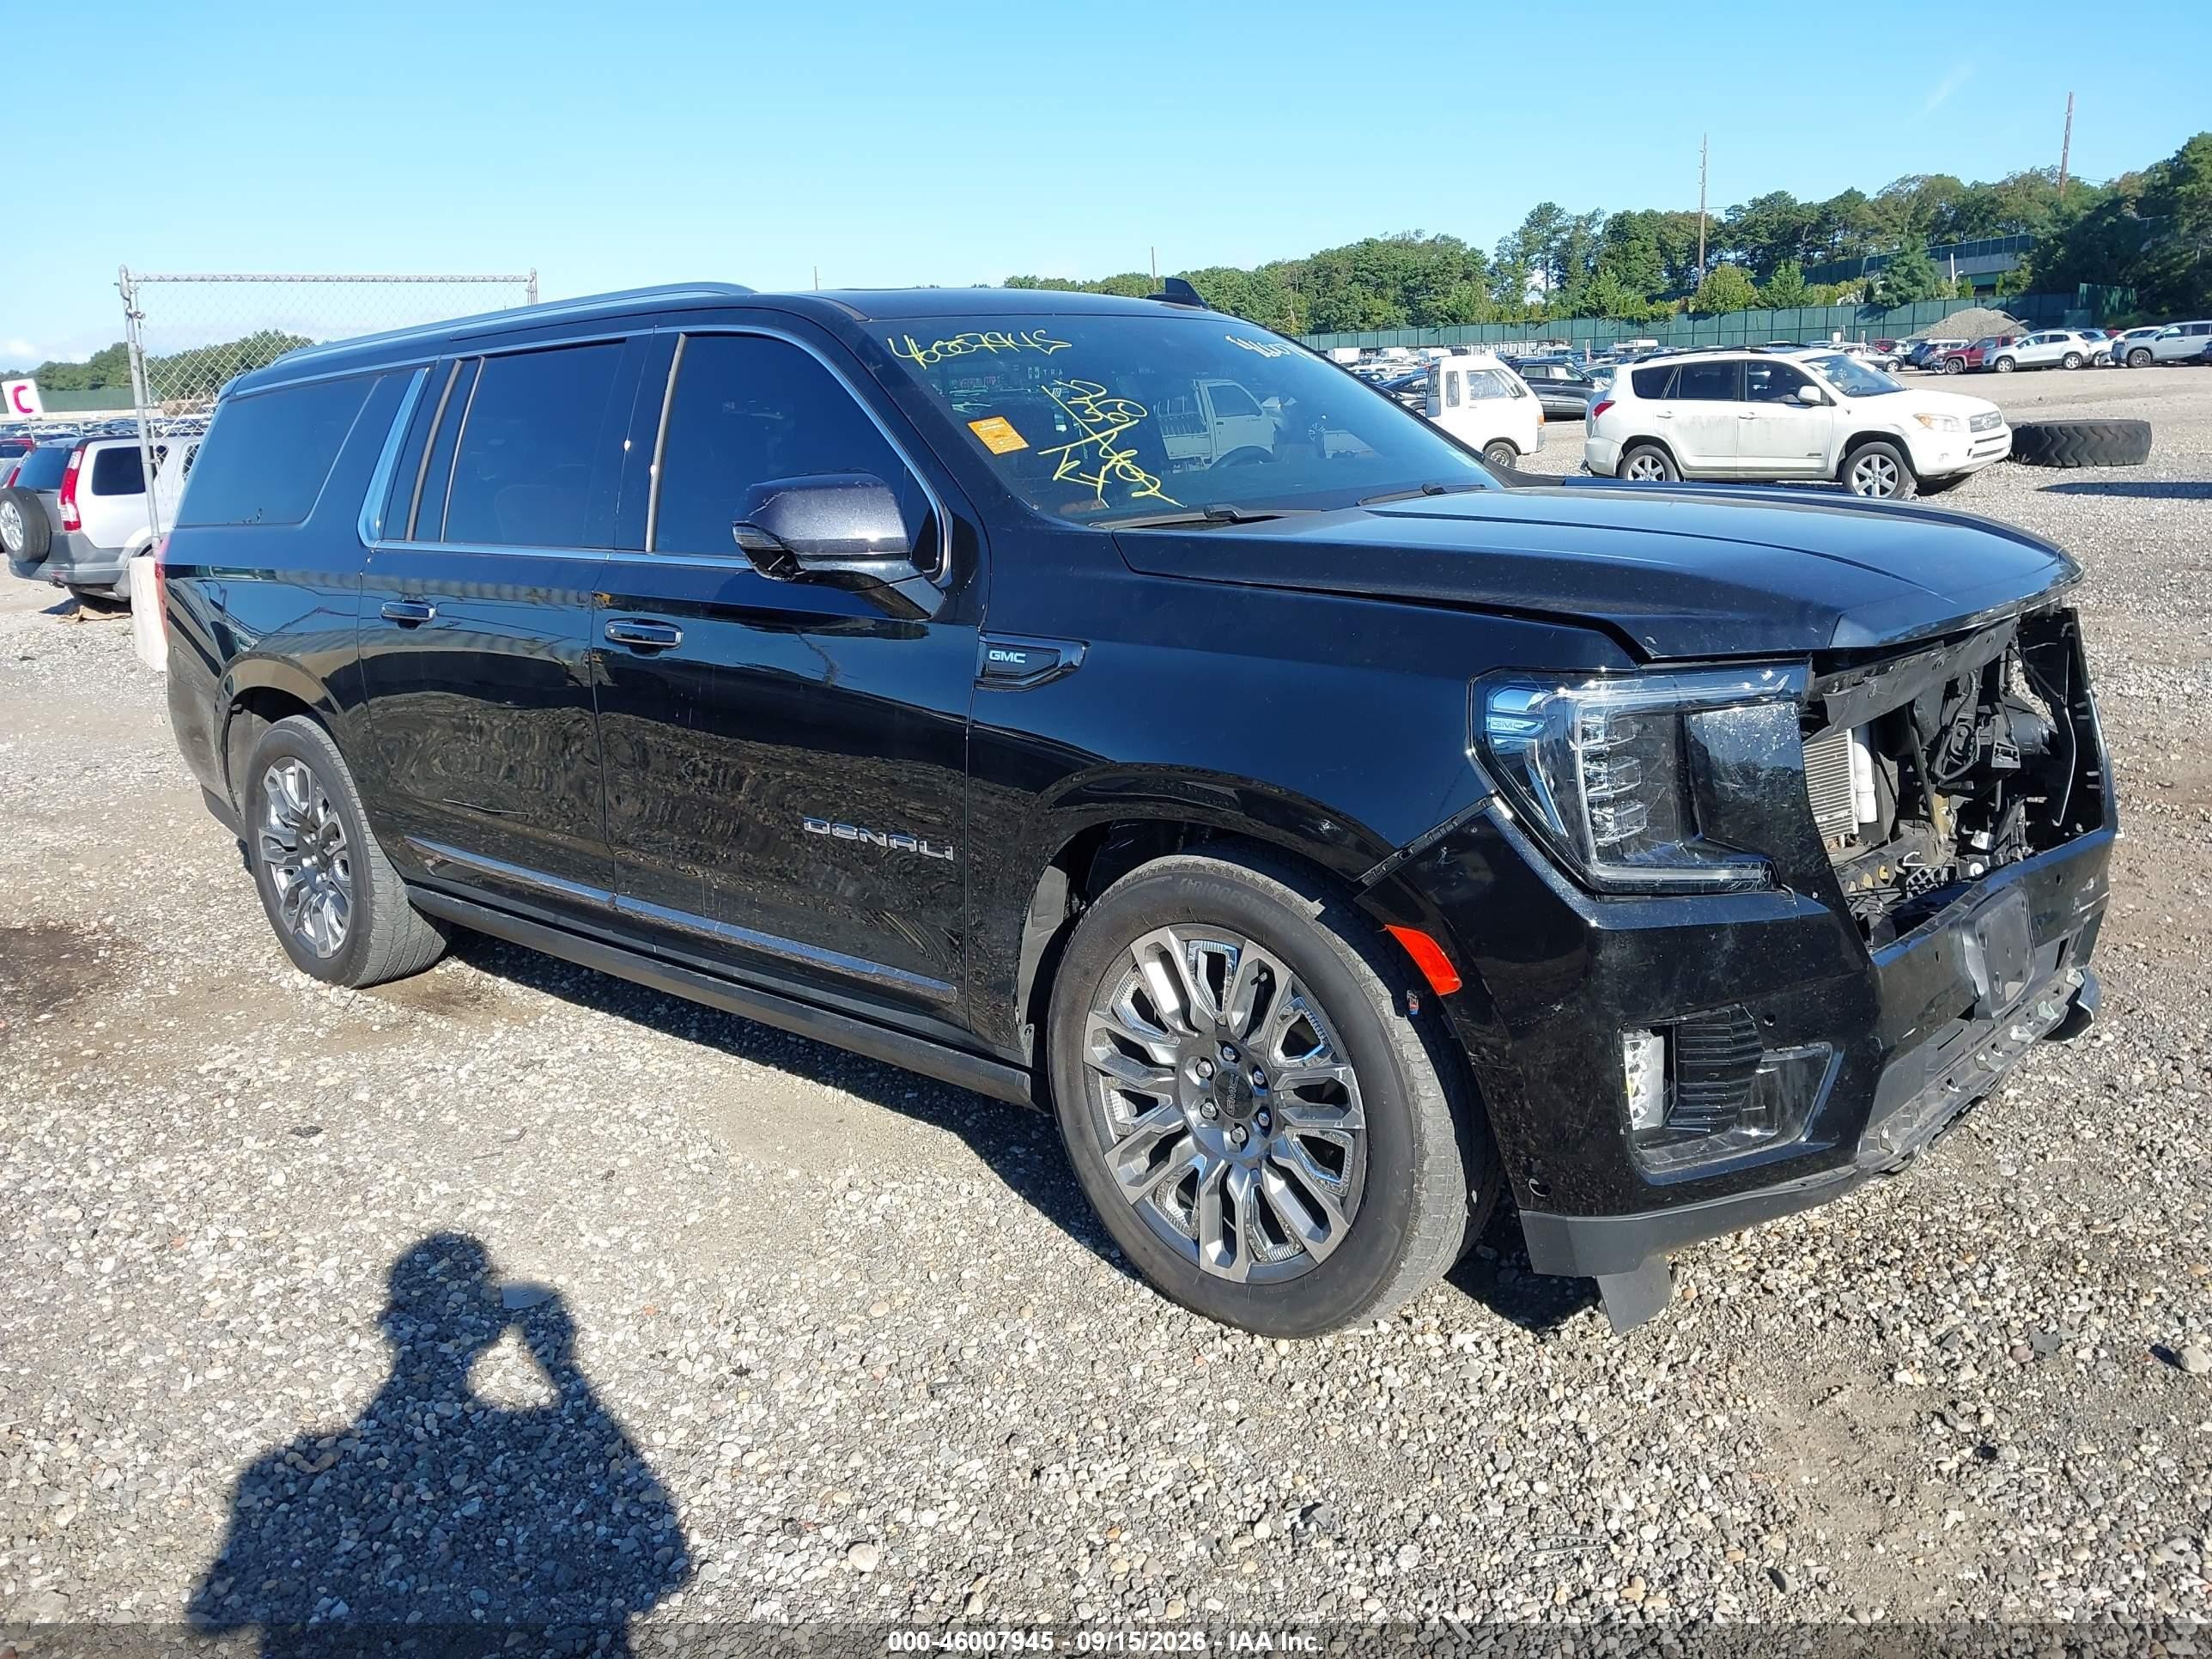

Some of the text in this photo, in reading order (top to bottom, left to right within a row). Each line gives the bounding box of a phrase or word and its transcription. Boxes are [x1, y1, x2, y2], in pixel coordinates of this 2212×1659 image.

[14, 386, 33, 413] C
[988, 650, 1026, 664] GMC
[803, 817, 955, 861] DENALI
[1226, 1073, 1239, 1115] GMC
